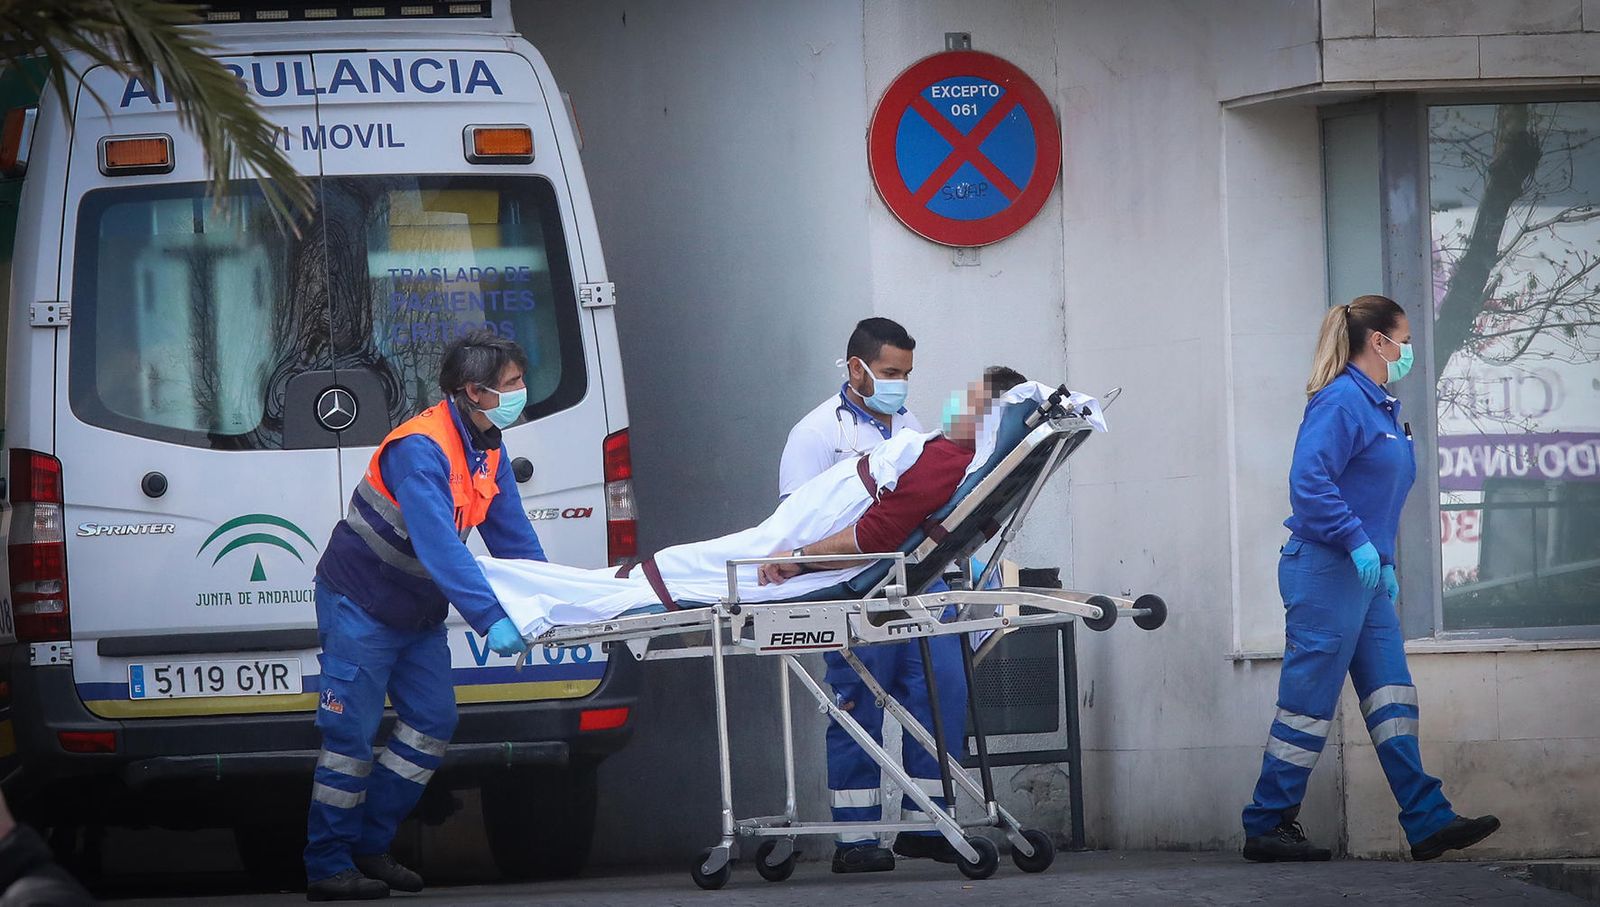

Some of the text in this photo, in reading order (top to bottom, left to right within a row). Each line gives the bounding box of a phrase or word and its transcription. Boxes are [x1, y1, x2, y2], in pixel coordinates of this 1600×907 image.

[931, 84, 1000, 98] EXCEPTO
[951, 103, 978, 116] 061
[302, 123, 405, 150] MOVIL
[387, 266, 531, 283] TRASLADO DE
[388, 289, 536, 313] PACIENTES
[561, 507, 593, 519] CDI
[196, 592, 233, 607] JUNTA
[238, 591, 252, 605] DE
[770, 630, 835, 646] FERNO
[154, 665, 225, 694] 5119
[236, 663, 290, 691] GYR
